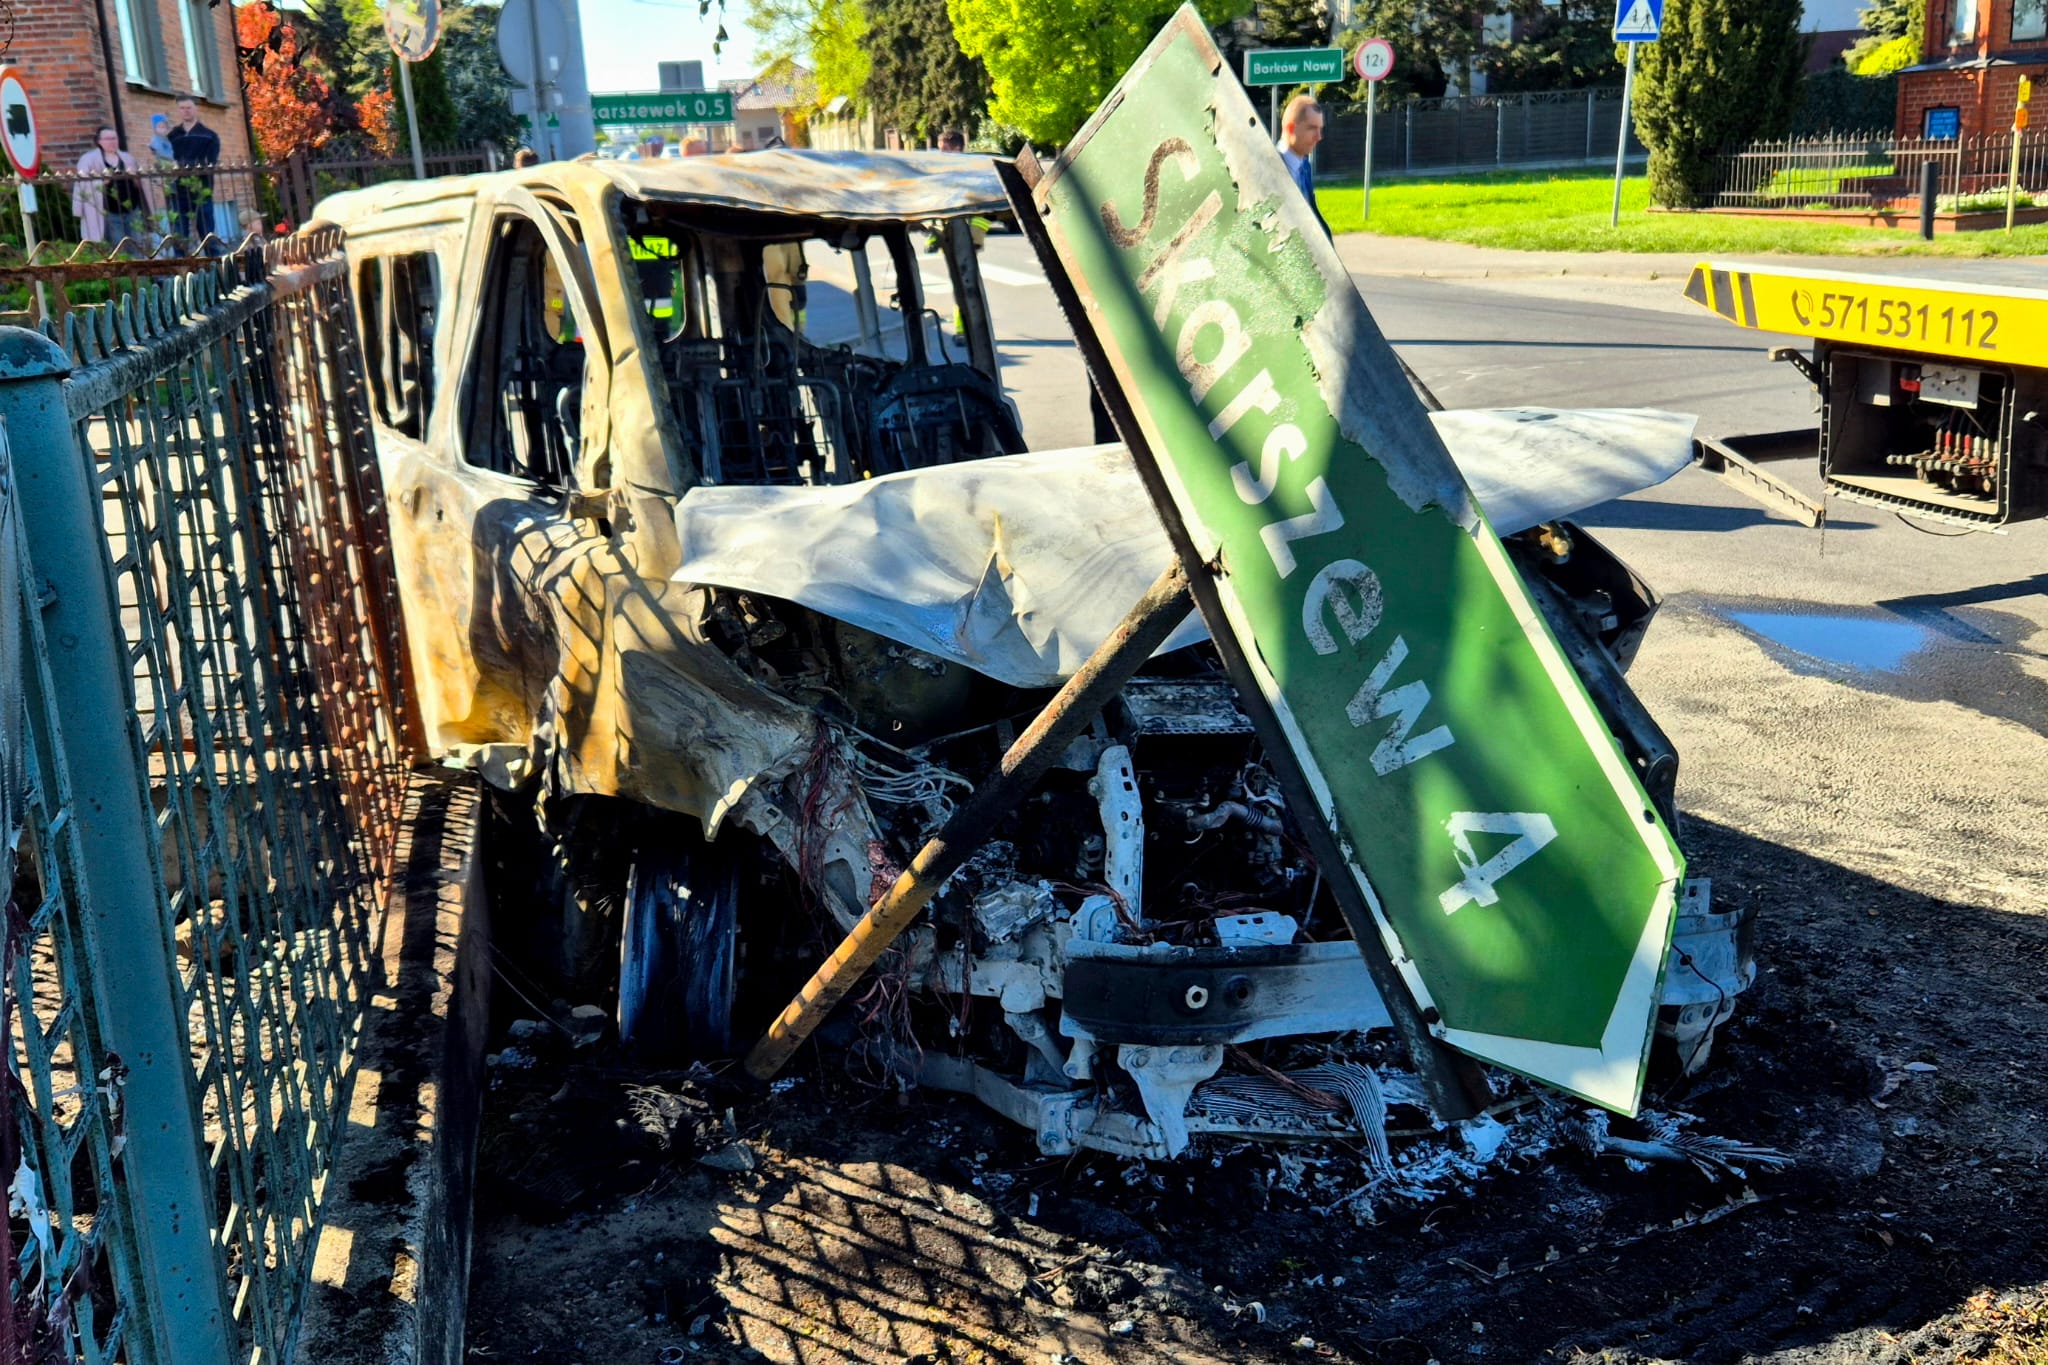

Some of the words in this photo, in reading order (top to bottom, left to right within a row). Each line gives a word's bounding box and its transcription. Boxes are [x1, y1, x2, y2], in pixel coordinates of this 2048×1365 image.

[1303, 60, 1335, 74] Nowy
[1819, 293, 1869, 333] 571
[1876, 300, 1930, 341] 531
[1940, 307, 1999, 351] 112
[1101, 136, 1456, 777] Skarszew
[1438, 811, 1559, 916] 4
